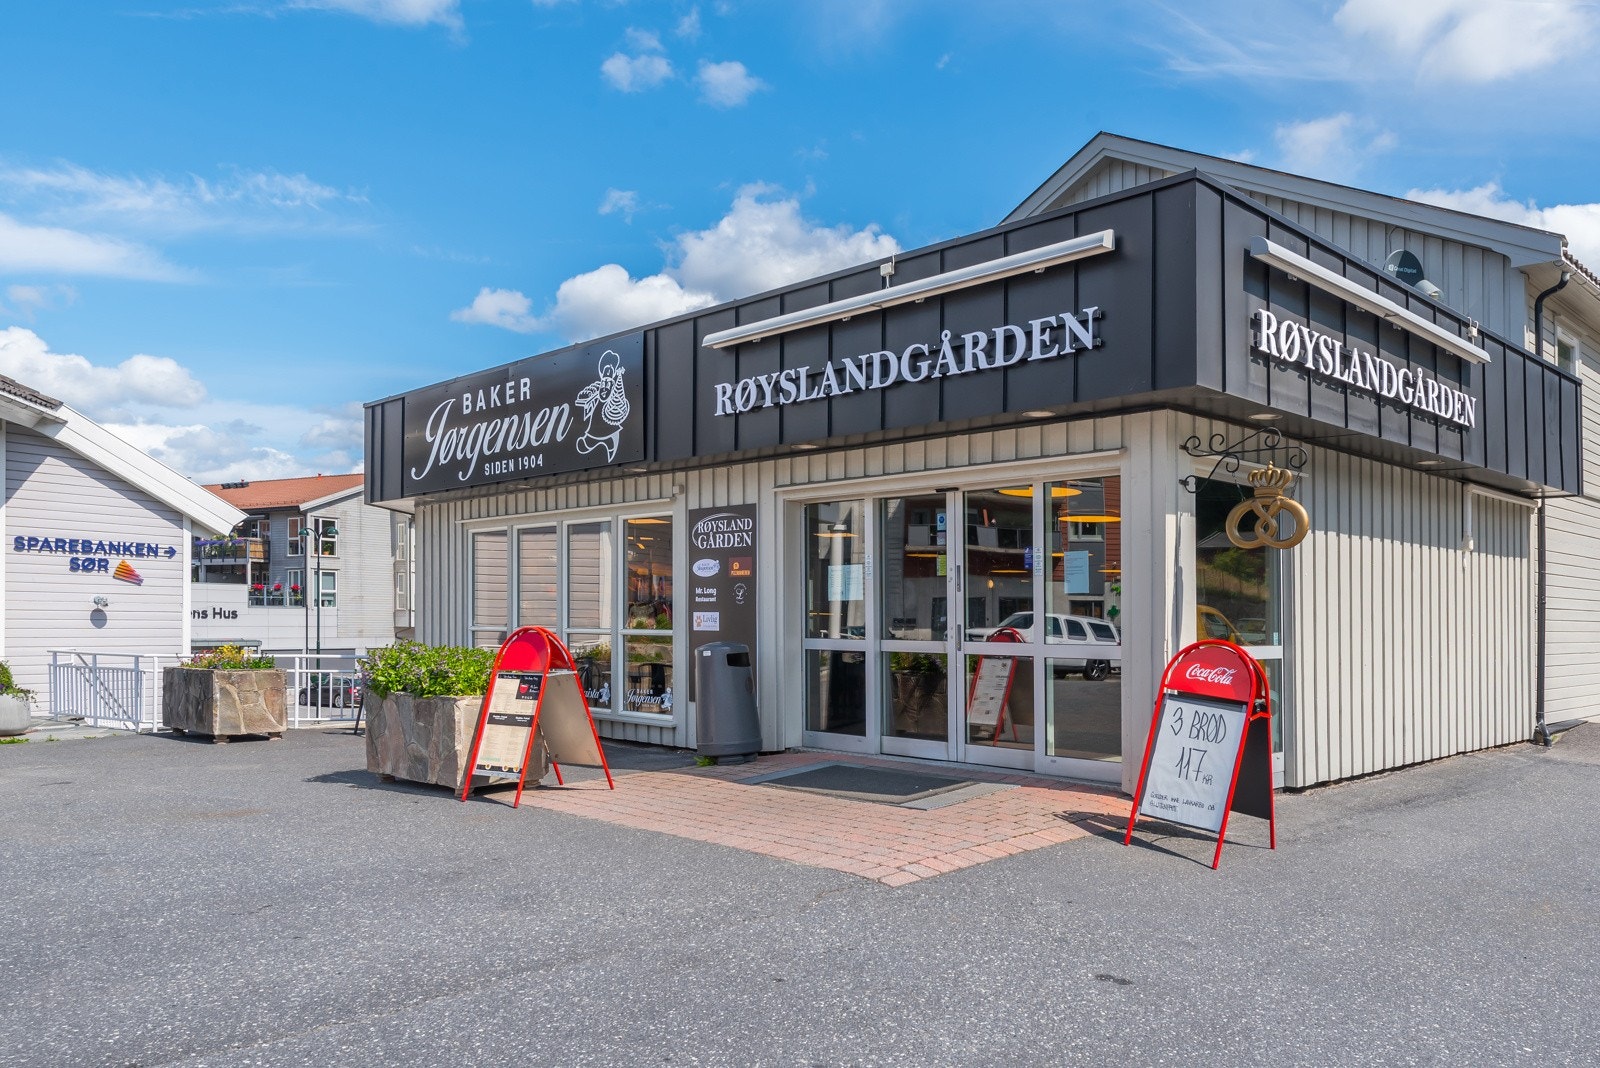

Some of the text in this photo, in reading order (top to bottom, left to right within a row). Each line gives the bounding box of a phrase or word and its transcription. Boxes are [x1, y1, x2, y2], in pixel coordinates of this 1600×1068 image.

[714, 306, 1099, 417] RØYSLANDGÅRDEN
[1258, 308, 1477, 429] RØYSLANDGÅRDEN
[462, 377, 531, 415] BAKER
[410, 398, 574, 481] Jørgensen
[484, 453, 543, 476] SIDEN 1904
[697, 518, 753, 534] RØYSLAND
[13, 536, 159, 557] SPAREBANKEN
[697, 531, 753, 549] GÅRDEN
[69, 557, 110, 573] SØR
[704, 587, 717, 596] Long
[191, 607, 238, 620] ns Hus
[1185, 663, 1238, 686] Coca-Cola
[1170, 706, 1227, 744] 3 BRØD
[1175, 746, 1207, 782] 117
